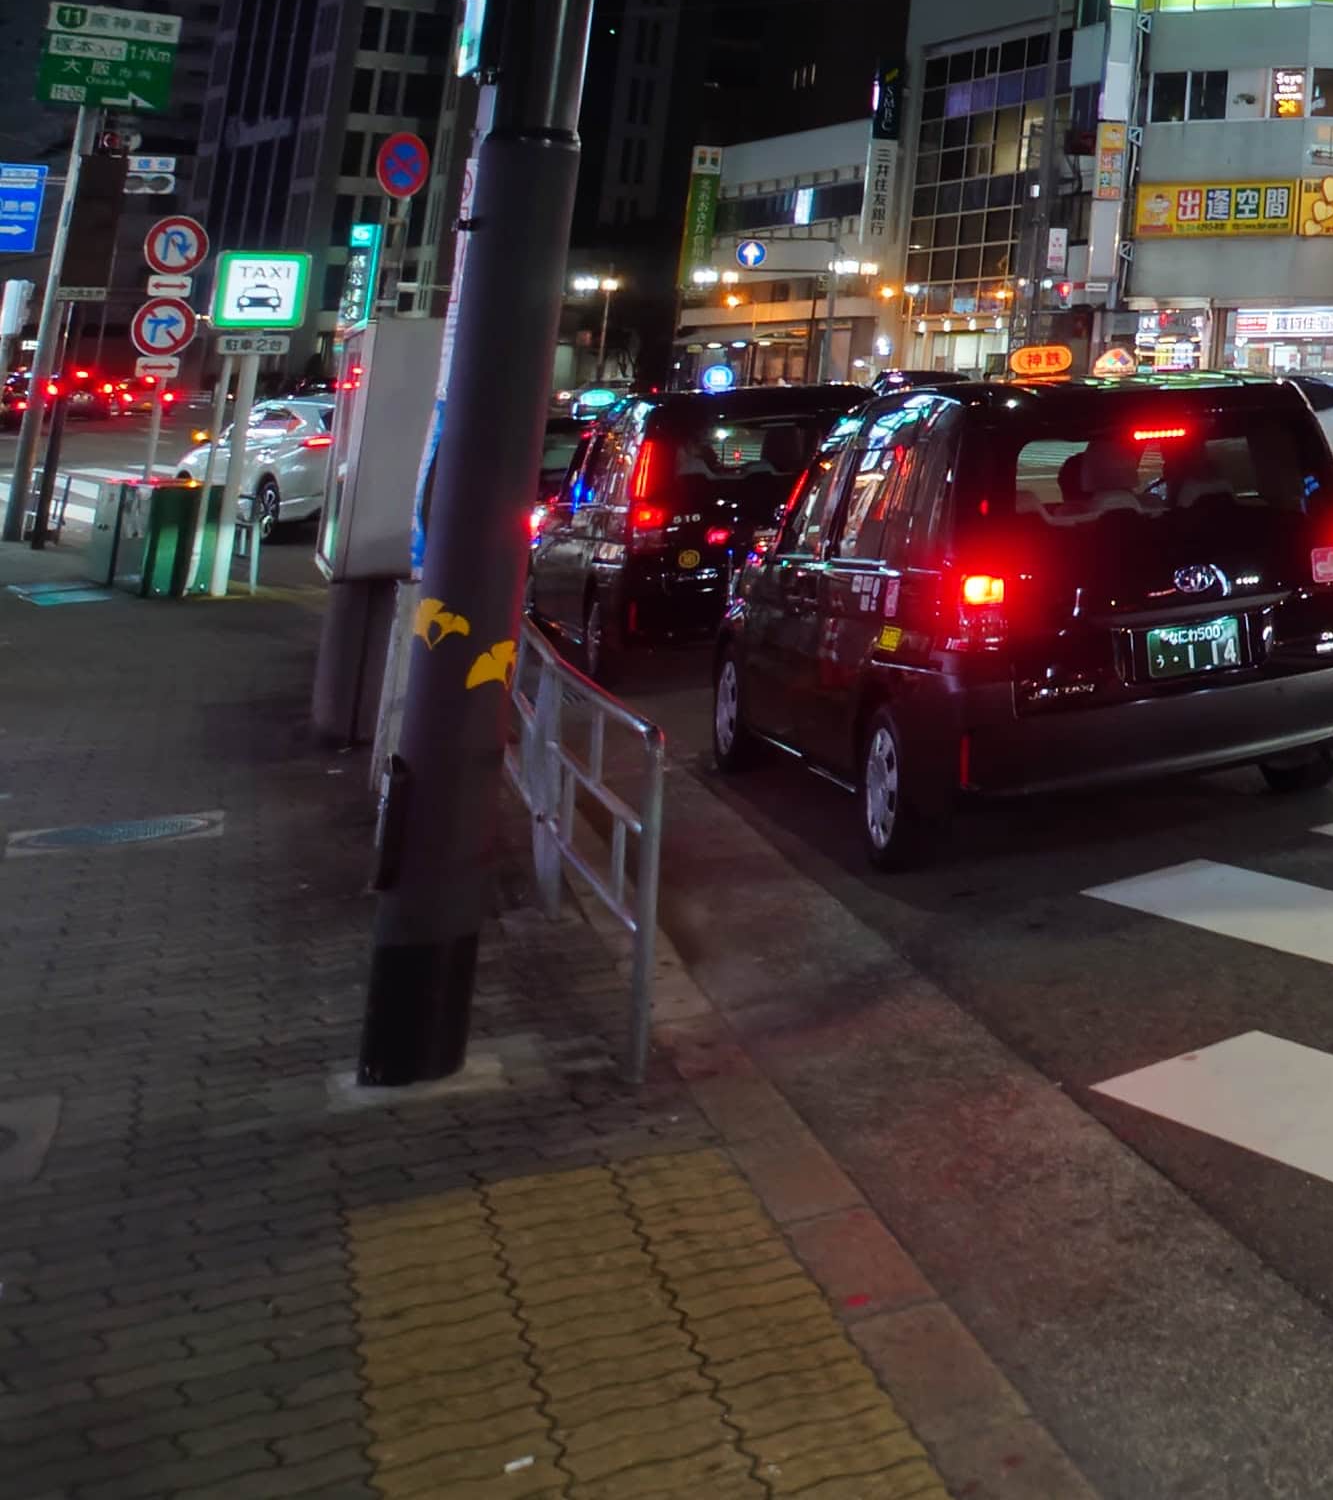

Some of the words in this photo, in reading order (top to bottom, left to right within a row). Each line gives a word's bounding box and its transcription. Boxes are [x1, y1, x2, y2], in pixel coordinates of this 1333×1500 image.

[870, 148, 892, 237] 三井住友銀行
[239, 266, 292, 279] TAXI
[225, 338, 283, 350] 駐車2台
